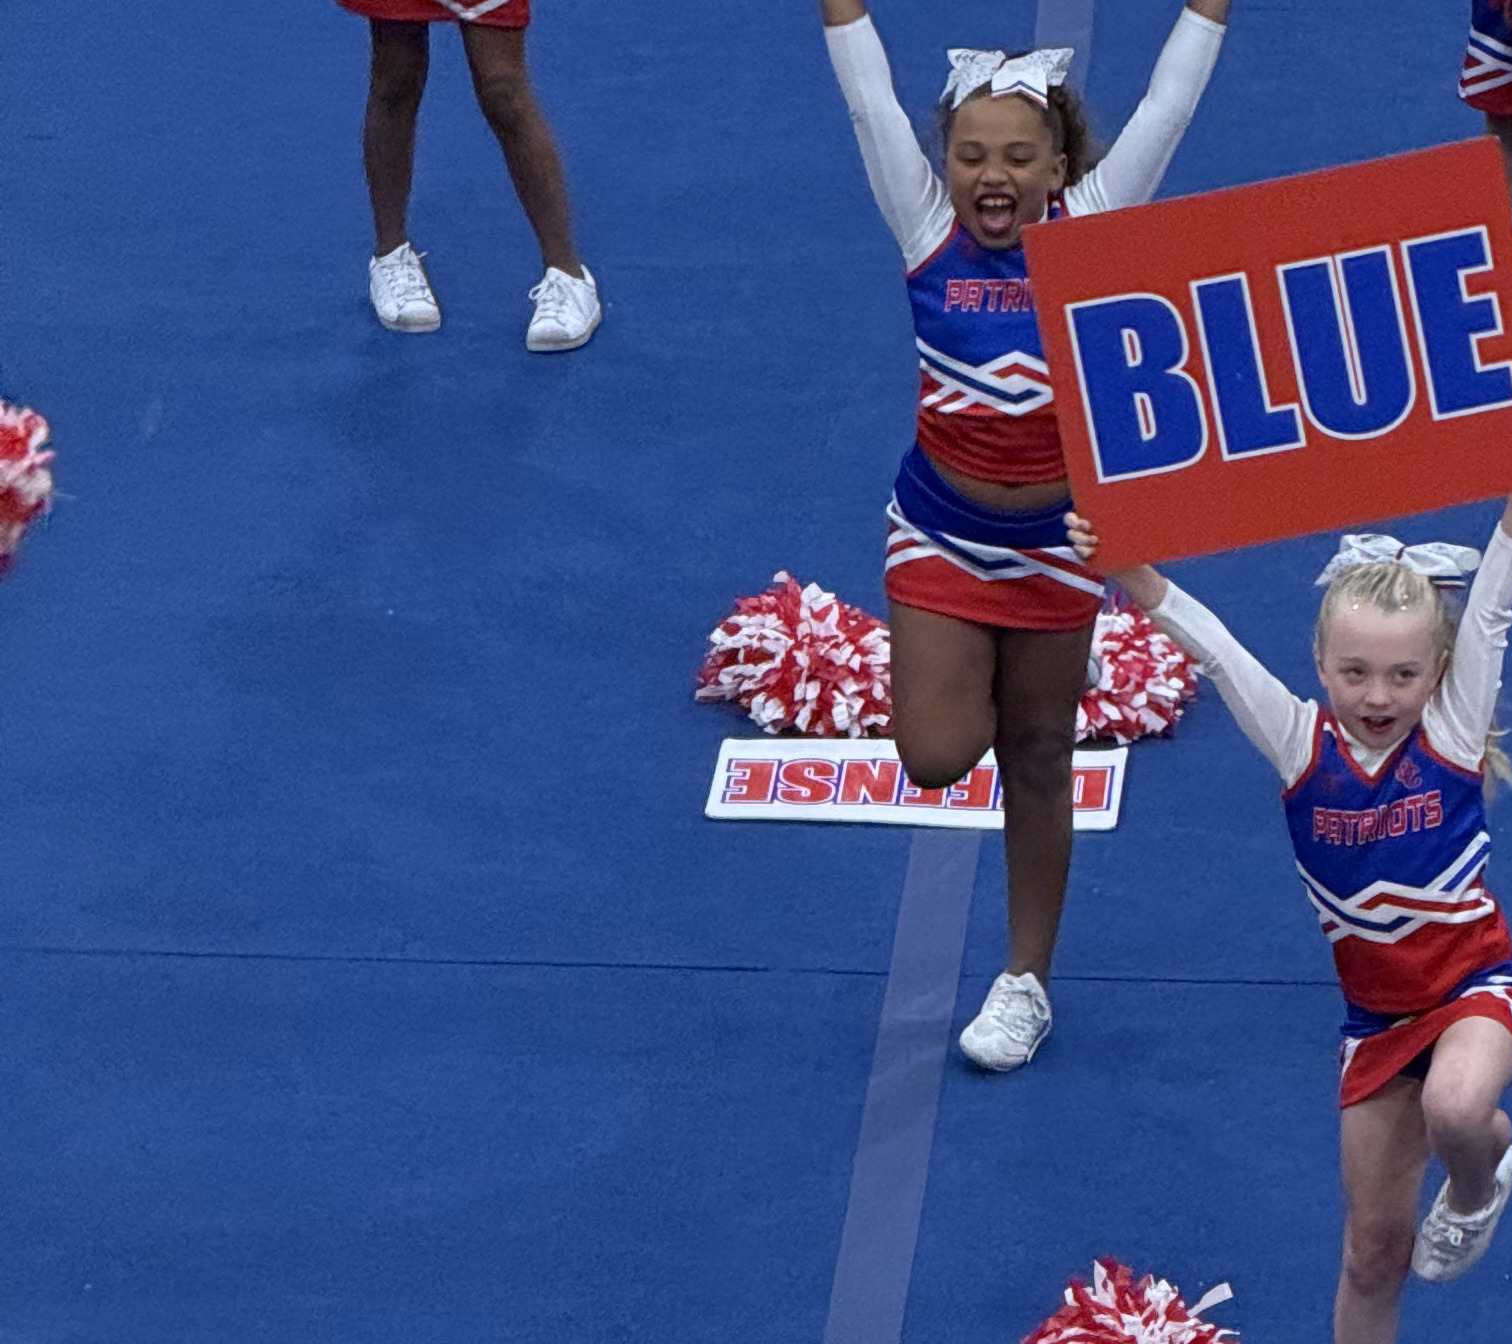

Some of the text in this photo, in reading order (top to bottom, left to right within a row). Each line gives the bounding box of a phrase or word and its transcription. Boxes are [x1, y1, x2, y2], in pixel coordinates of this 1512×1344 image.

[943, 277, 1037, 313] PATRI
[720, 758, 1116, 812] DFNSE
[1312, 790, 1444, 847] PATRIOTS
